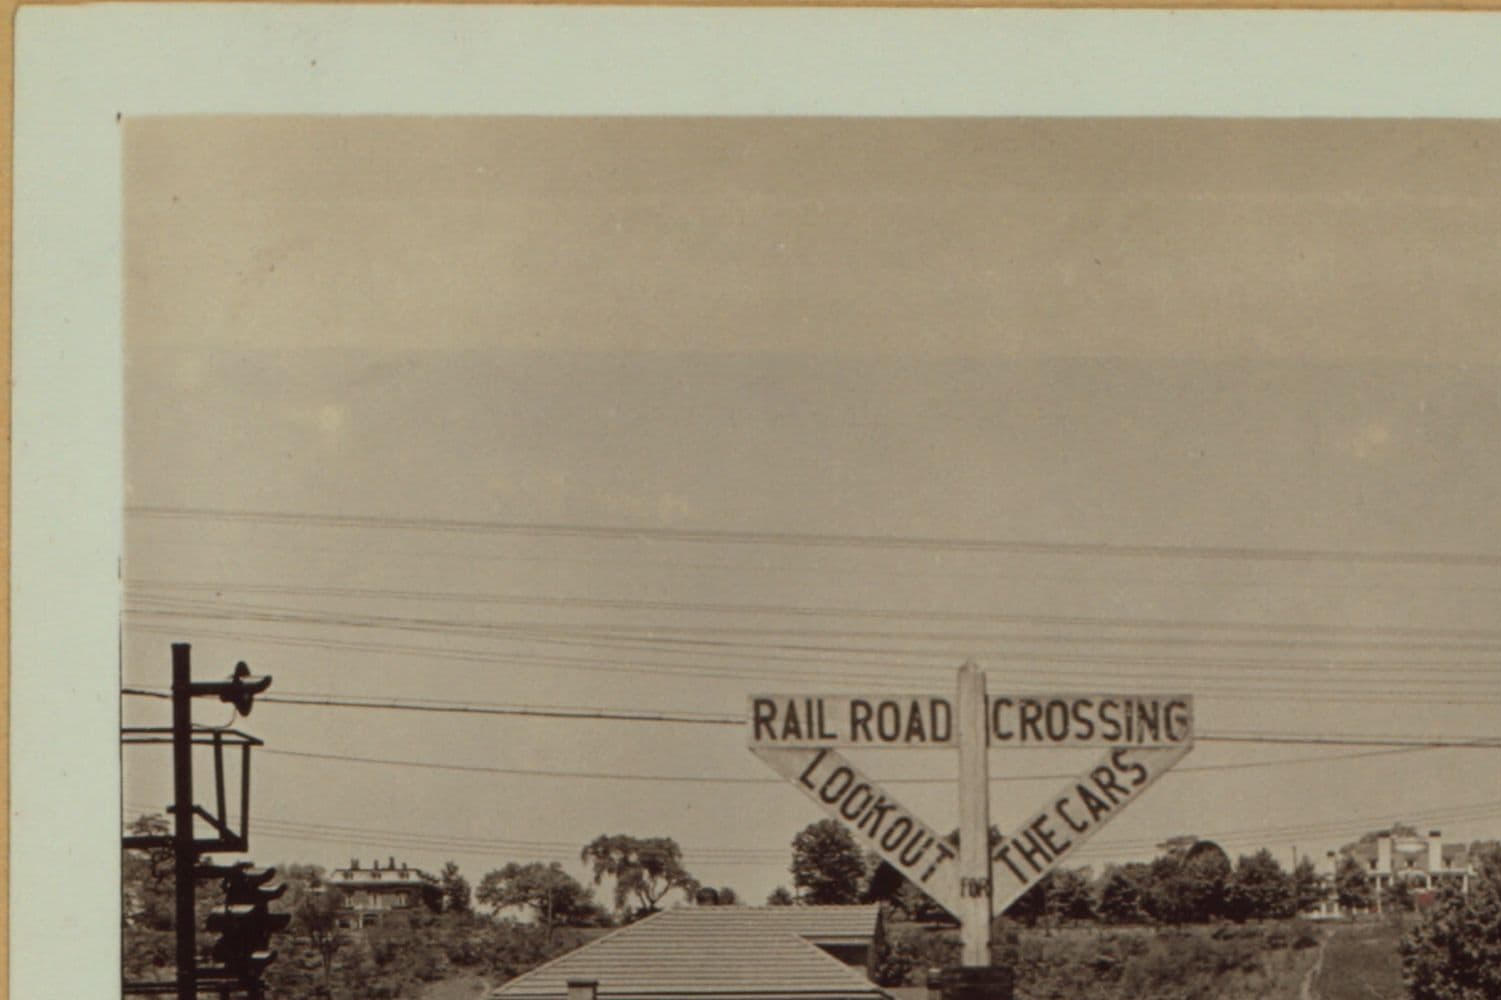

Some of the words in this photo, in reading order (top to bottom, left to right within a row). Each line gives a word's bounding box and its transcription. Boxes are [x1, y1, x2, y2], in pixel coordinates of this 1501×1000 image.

[753, 699, 837, 741] RAIL
[851, 699, 952, 742] ROAD
[992, 698, 1188, 743] CROSSING
[993, 813, 1072, 884] THE
[1056, 749, 1147, 832] CARS
